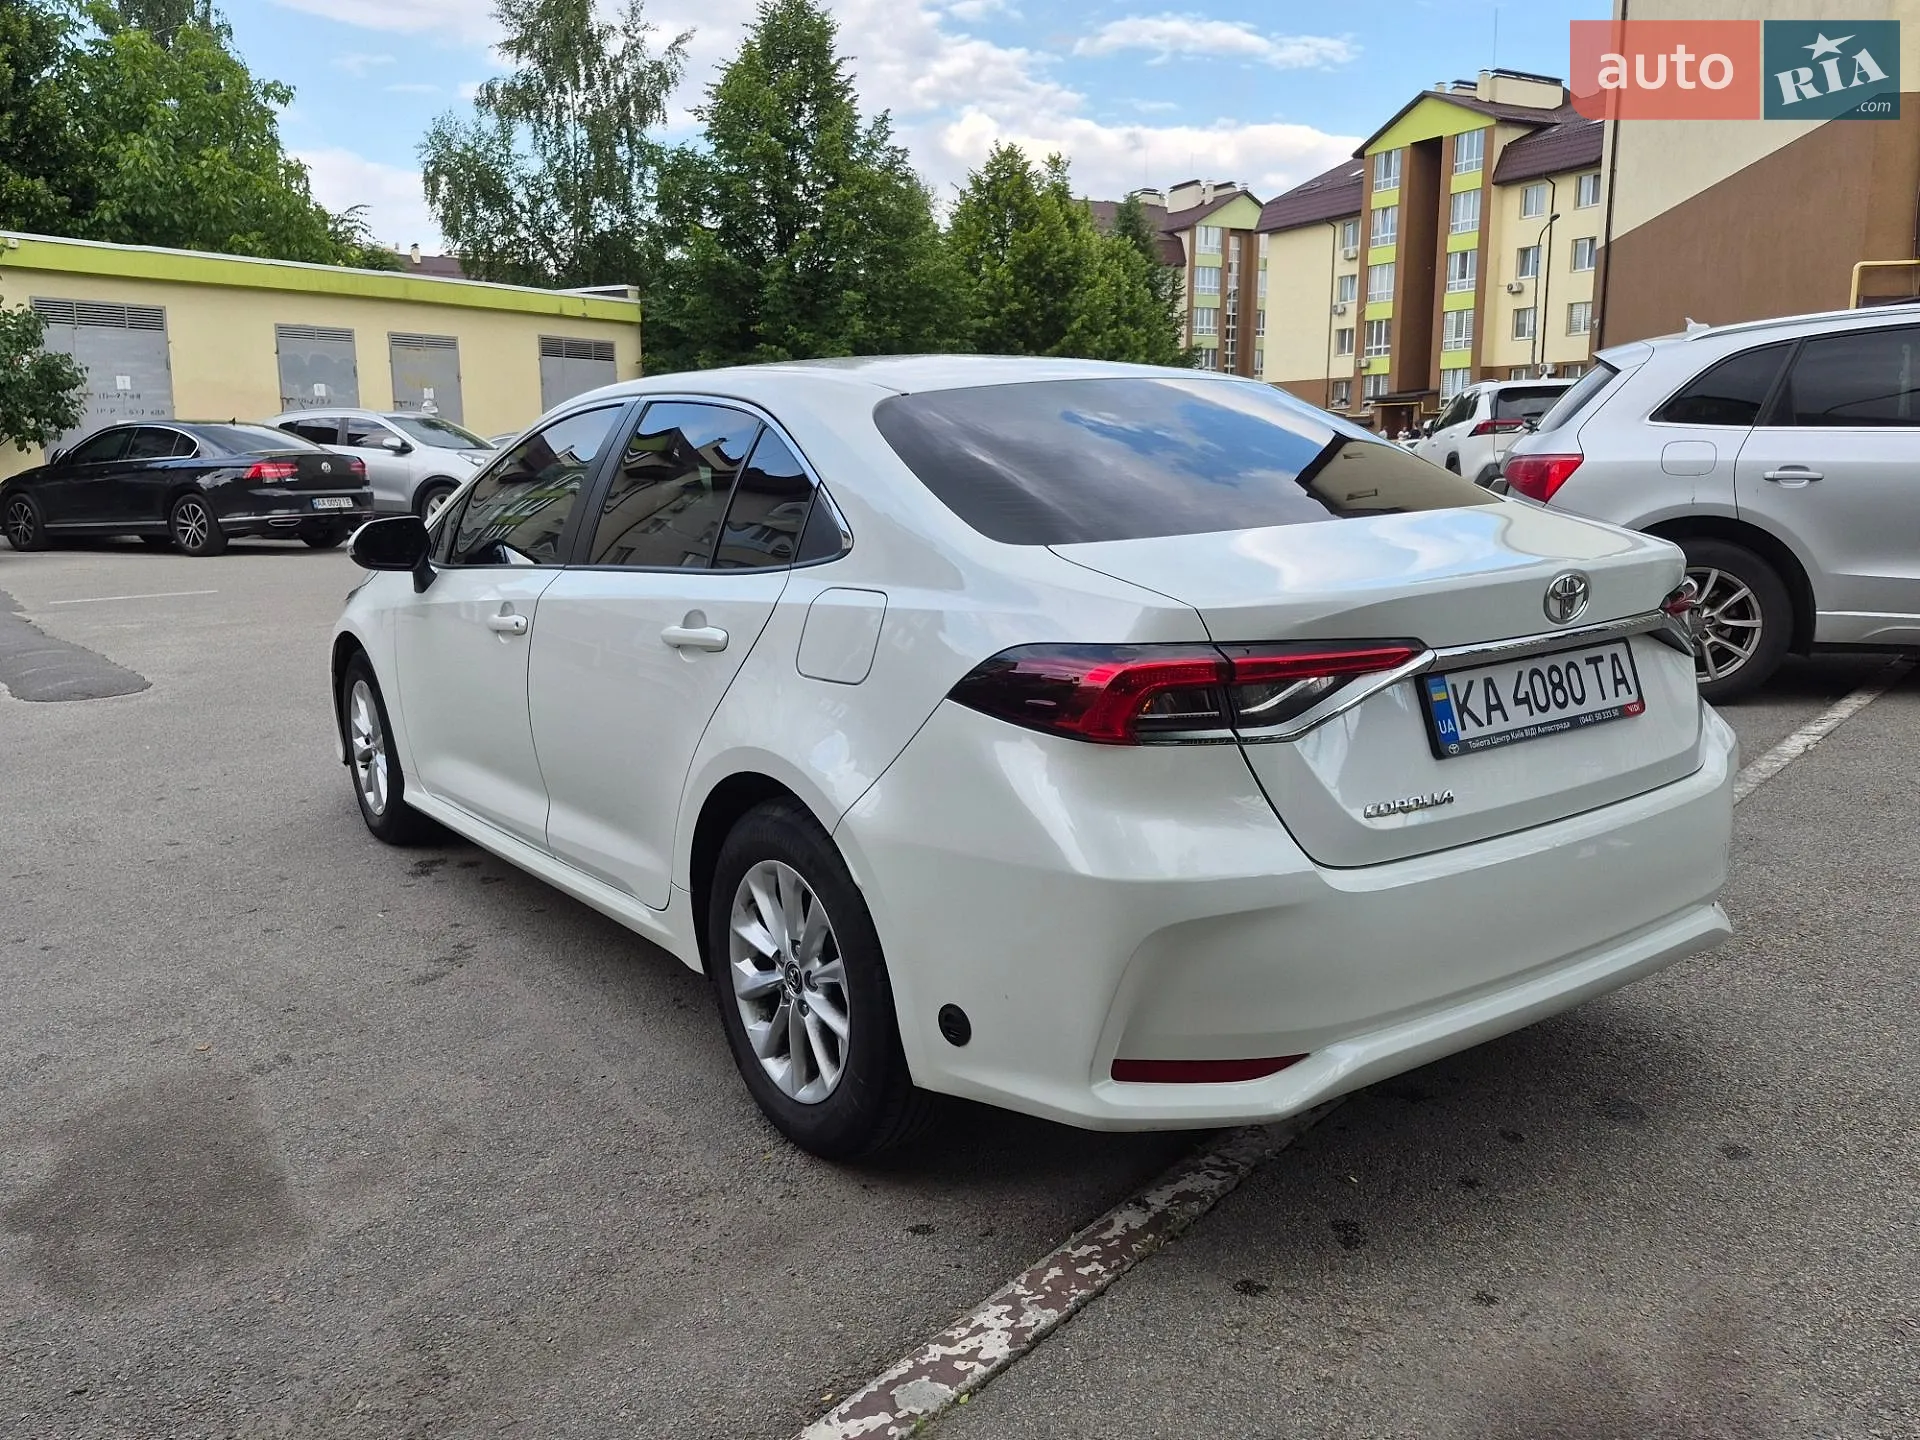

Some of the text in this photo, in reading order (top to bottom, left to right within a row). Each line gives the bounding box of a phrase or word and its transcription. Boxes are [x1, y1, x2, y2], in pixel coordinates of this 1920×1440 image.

[1450, 652, 1633, 732] KA 4080 TA
[1438, 718, 1456, 734] UA
[1491, 735, 1511, 745] Центр
[1537, 721, 1570, 734] Автострада
